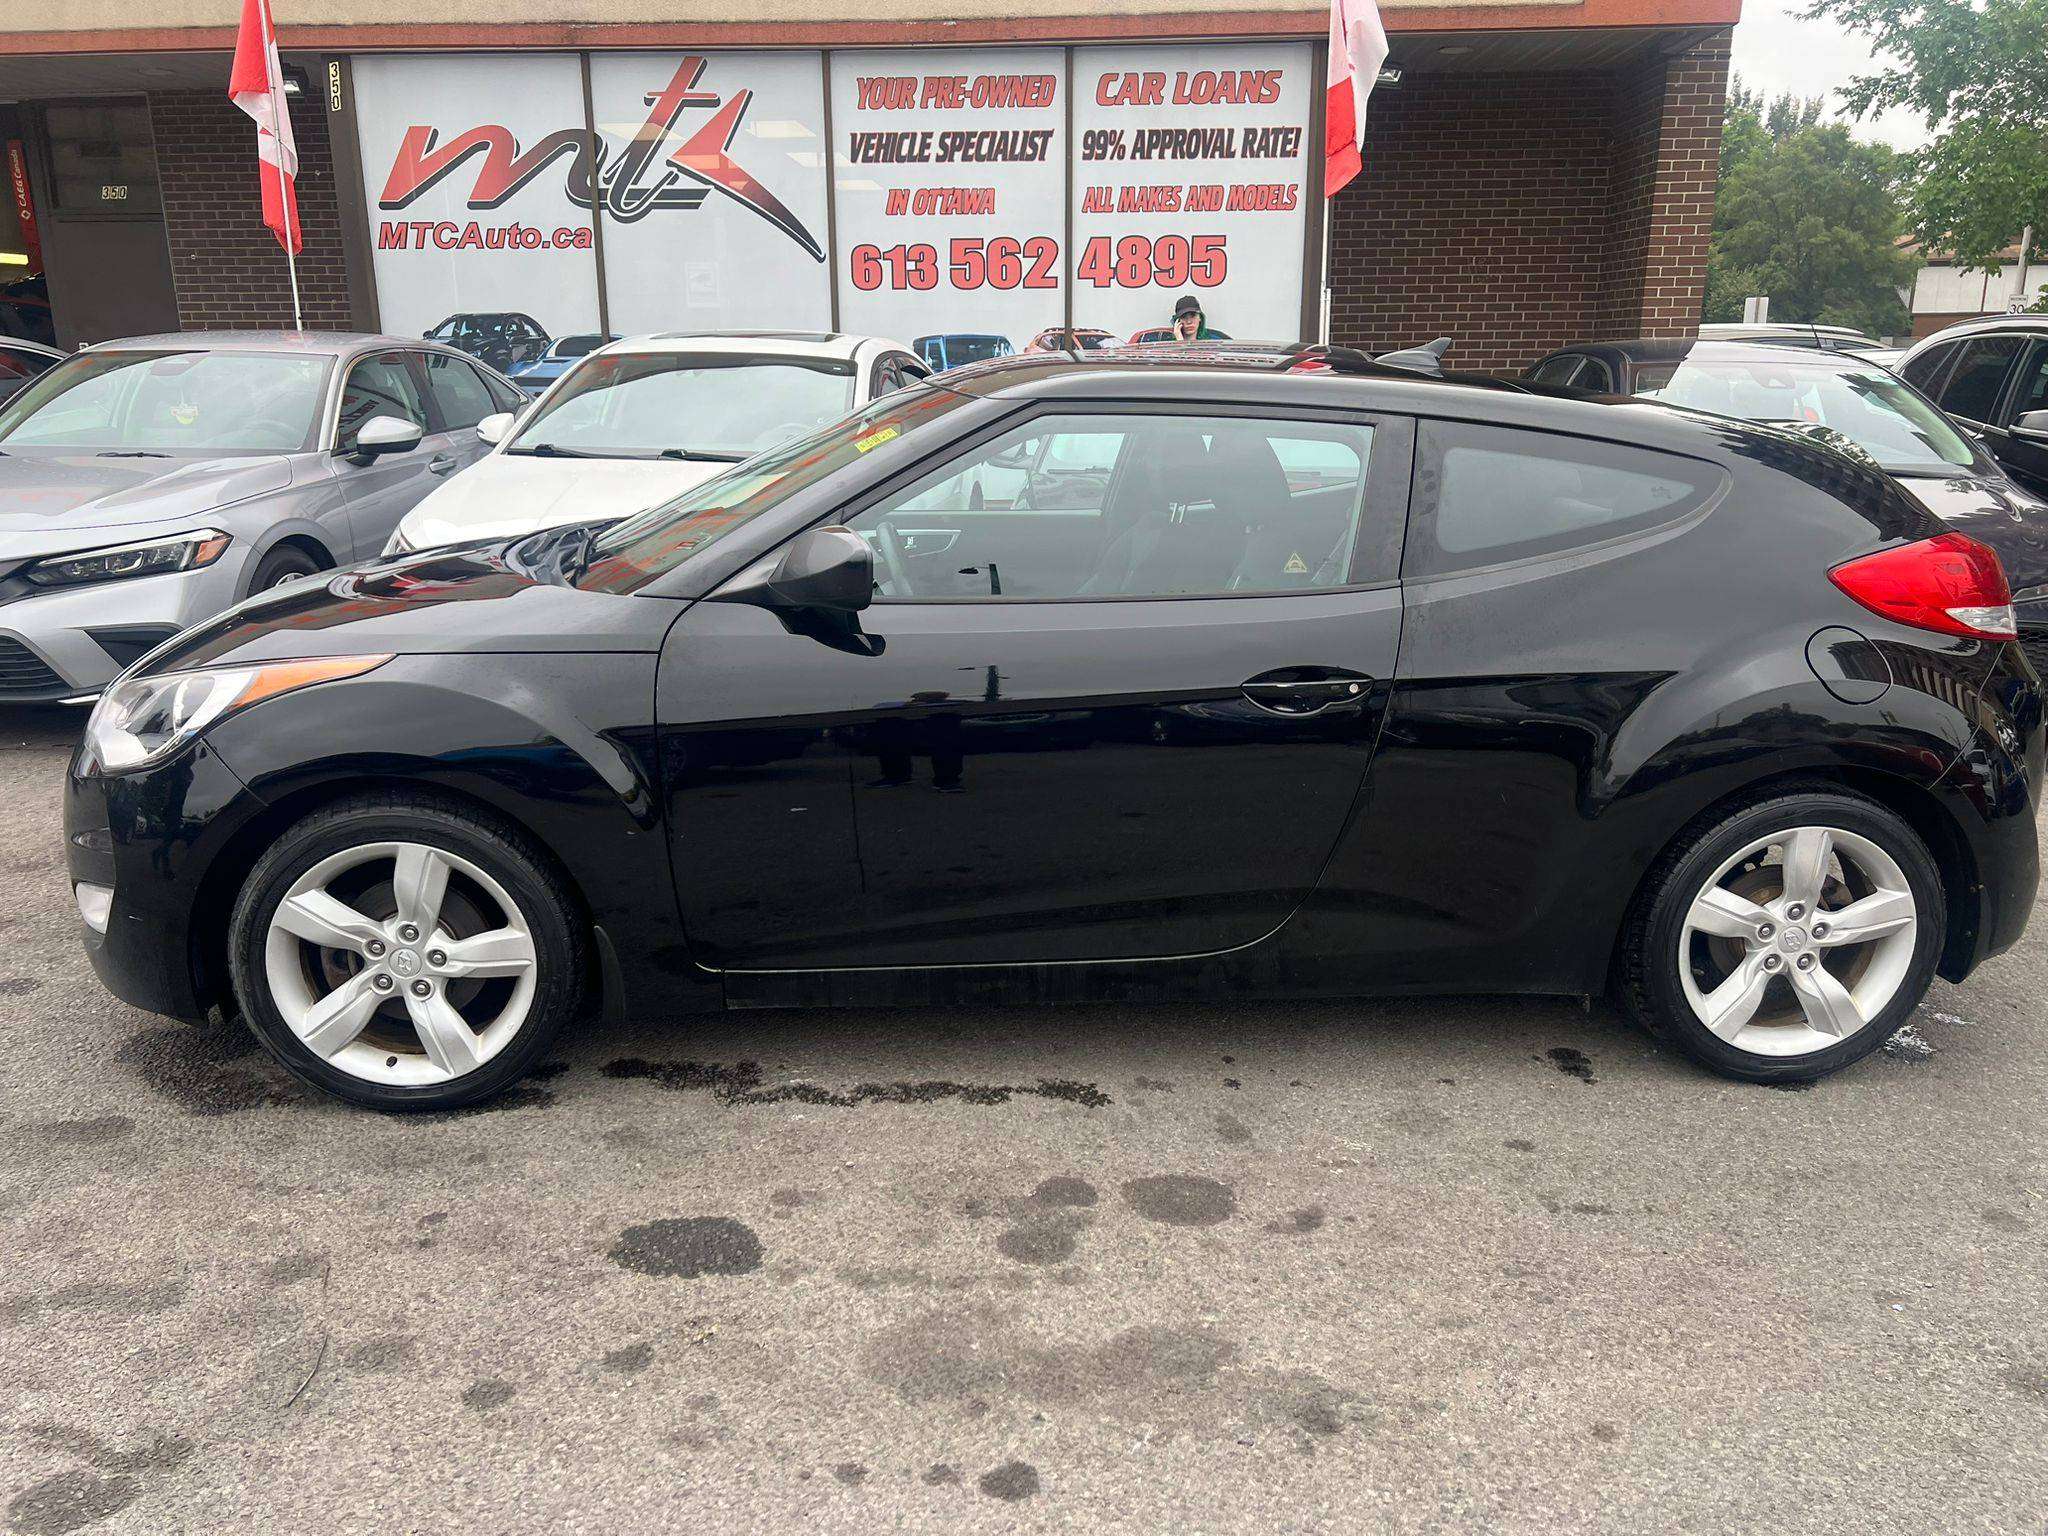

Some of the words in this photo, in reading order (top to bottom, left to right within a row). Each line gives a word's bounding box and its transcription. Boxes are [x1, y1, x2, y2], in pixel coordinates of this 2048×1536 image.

[331, 63, 340, 110] 350
[856, 77, 918, 110] YOUR
[920, 75, 1057, 109] PRE-OWNED
[1096, 72, 1167, 106] CAR
[1172, 70, 1283, 105] LOANS
[850, 131, 934, 163] VEHICLE
[935, 128, 1055, 163] SPECIALIST
[1082, 129, 1126, 160] 99%
[1130, 127, 1236, 160] APPROVAL
[1240, 126, 1303, 159] RATE!
[102, 186, 128, 199] 350
[886, 189, 910, 215] IN
[912, 187, 996, 215] OTTAWA
[1081, 186, 1114, 213] ALL
[1116, 185, 1182, 213] MAKES
[1183, 185, 1224, 211] AND
[1225, 184, 1299, 211] MODELS
[378, 221, 593, 251] MTCAuto.ca
[851, 243, 939, 291] 613
[949, 236, 1060, 290] 562
[1077, 234, 1228, 289] 4895
[2009, 304, 2025, 315] 30
